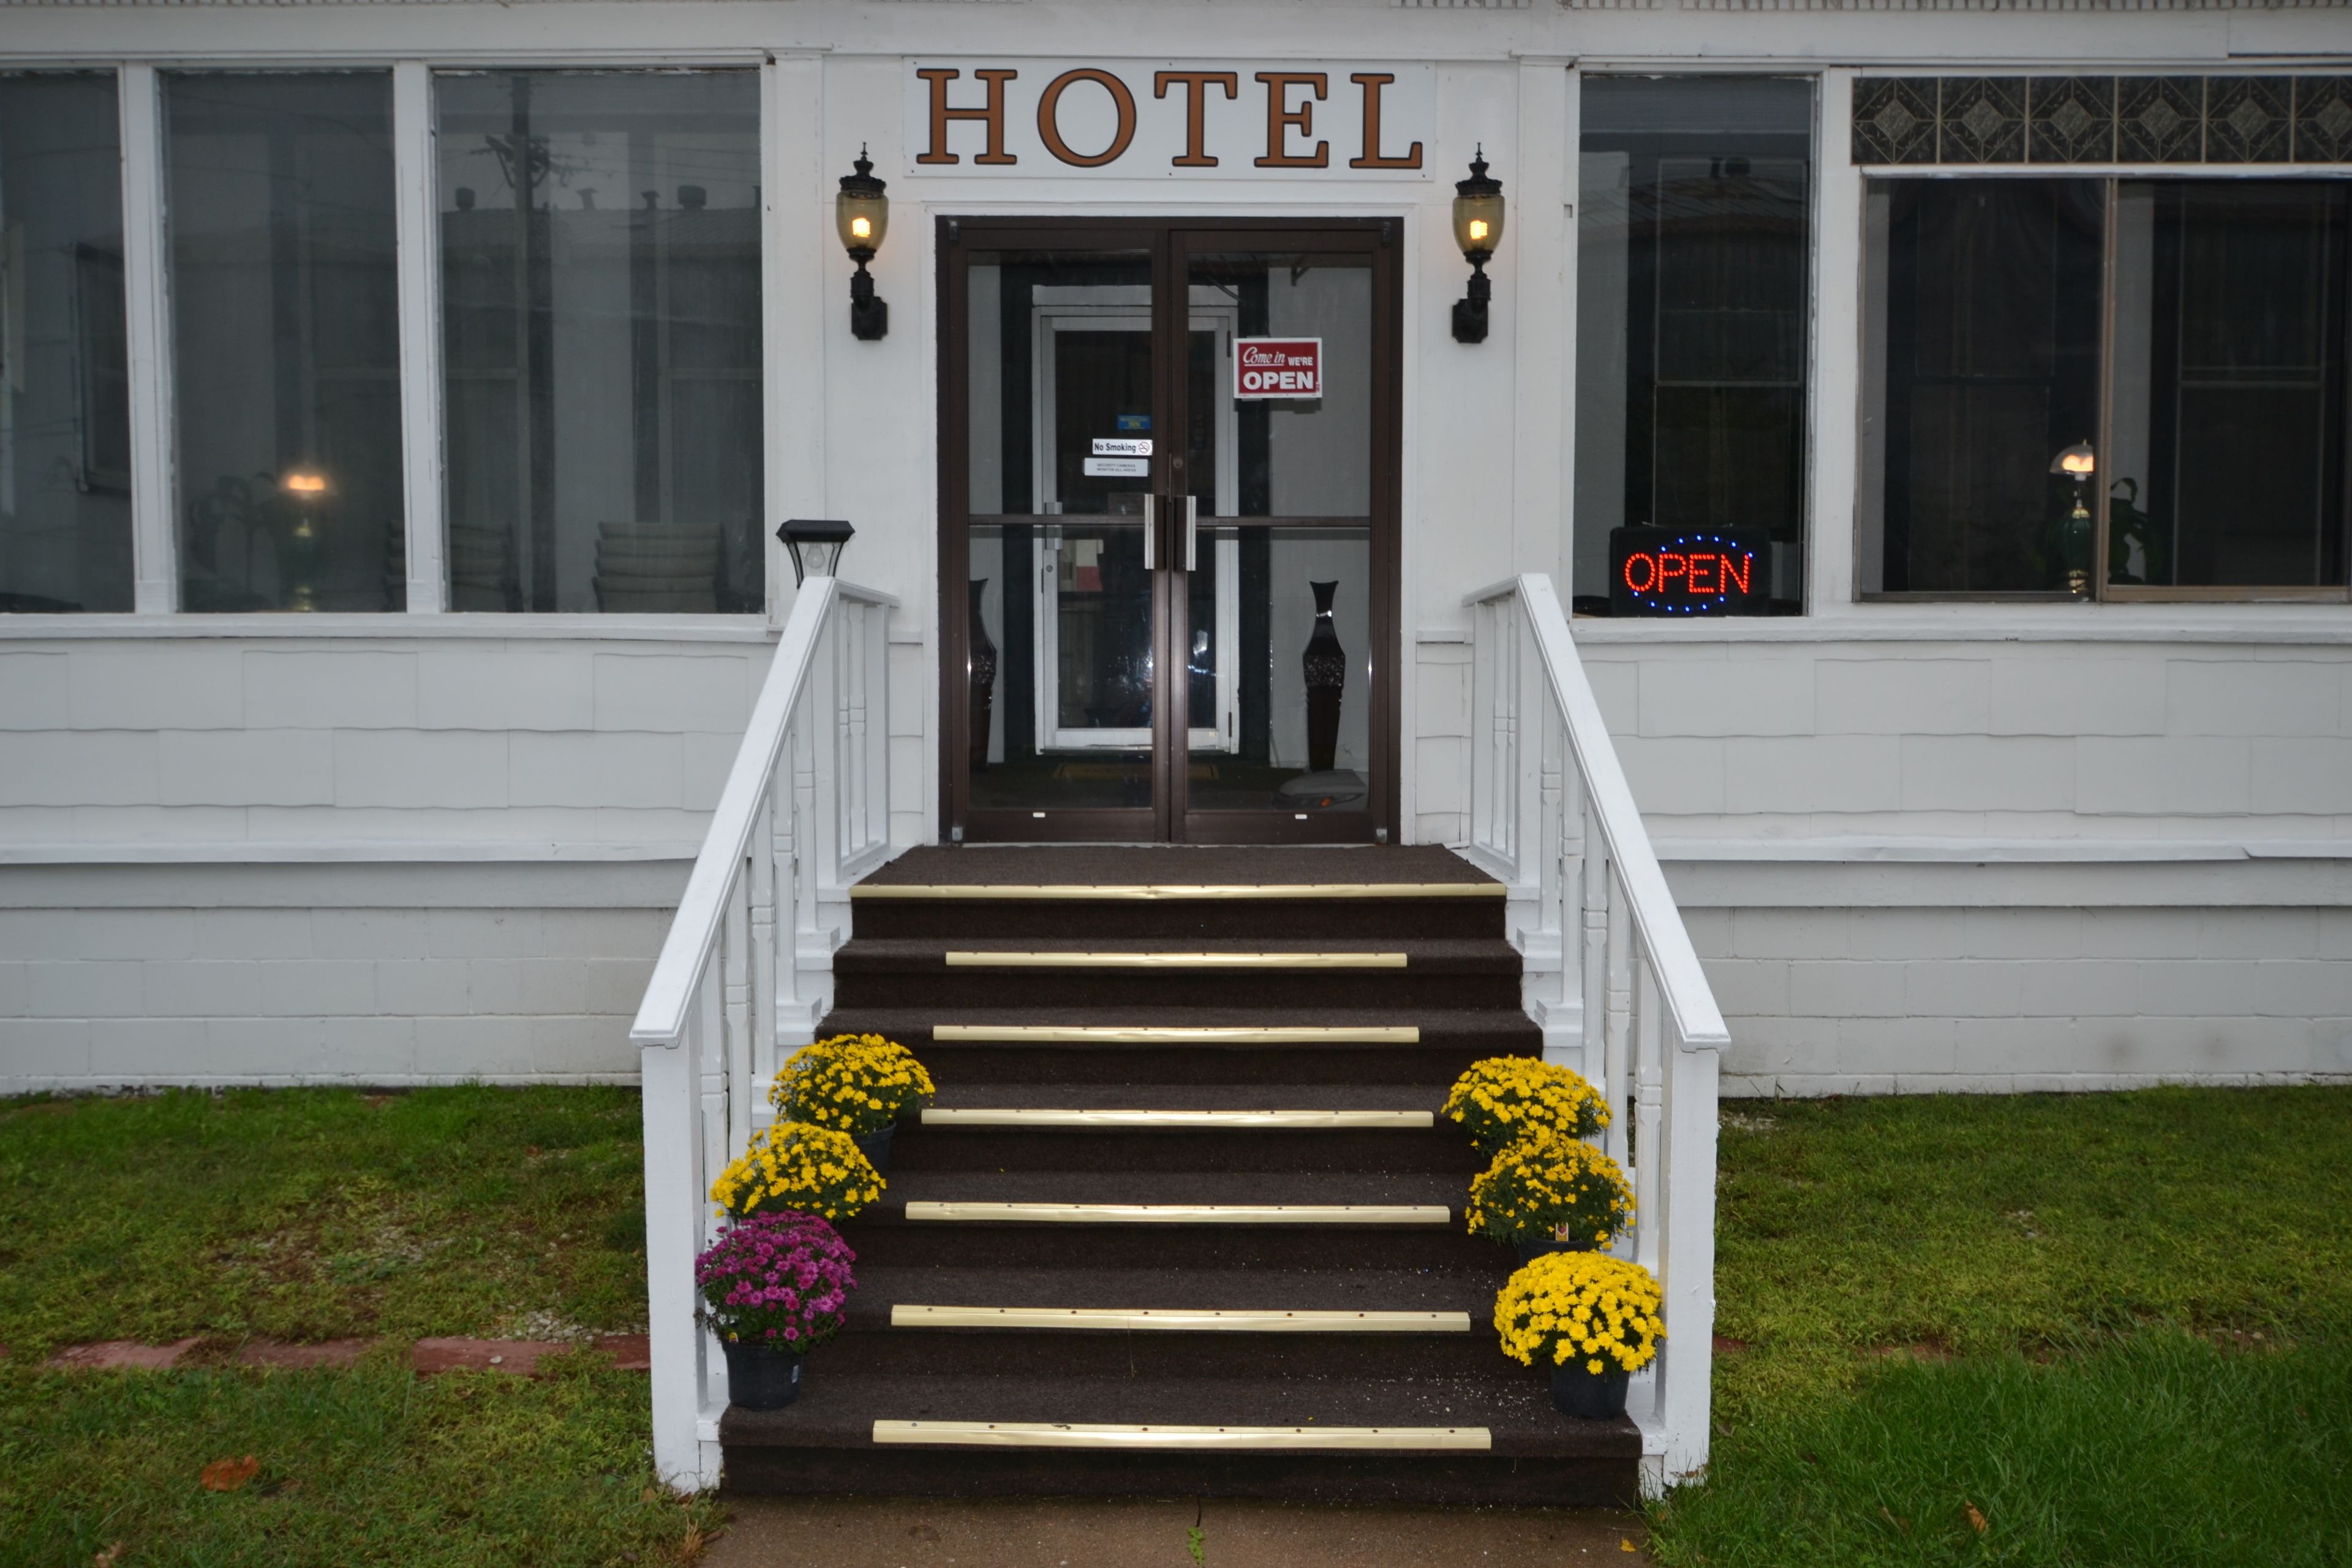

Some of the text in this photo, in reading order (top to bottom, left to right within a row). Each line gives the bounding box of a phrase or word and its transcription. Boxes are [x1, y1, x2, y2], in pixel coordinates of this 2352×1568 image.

[916, 67, 1423, 168] HOTEL
[1243, 346, 1313, 366] Come in WE'RE
[1243, 371, 1313, 390] OPEN
[1106, 443, 1136, 453] Smoking
[1624, 552, 1751, 594] OPEN
